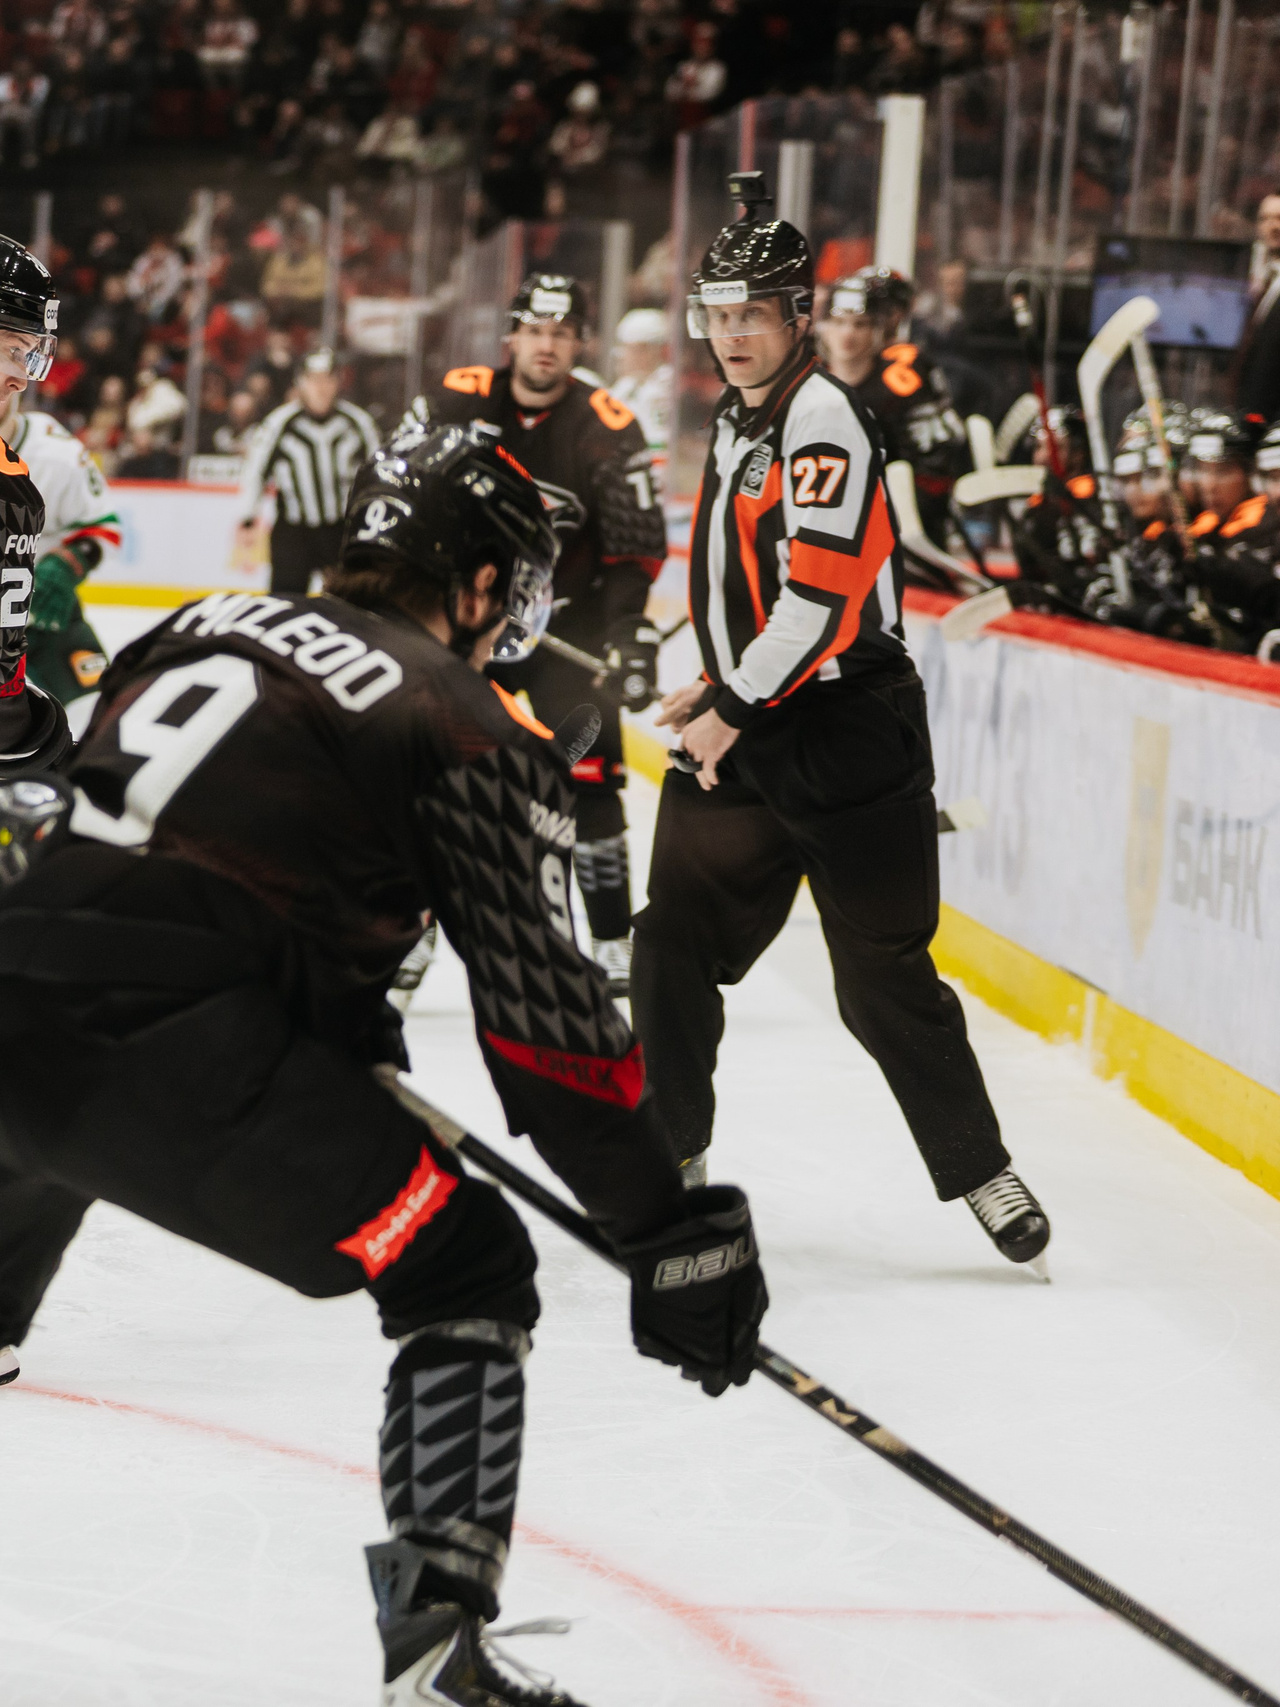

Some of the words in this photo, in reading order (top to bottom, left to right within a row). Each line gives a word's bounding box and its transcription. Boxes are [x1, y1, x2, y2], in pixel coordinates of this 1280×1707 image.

[793, 454, 848, 505] 27
[357, 500, 387, 541] 9
[70, 653, 259, 847] 9
[540, 852, 573, 943] 9
